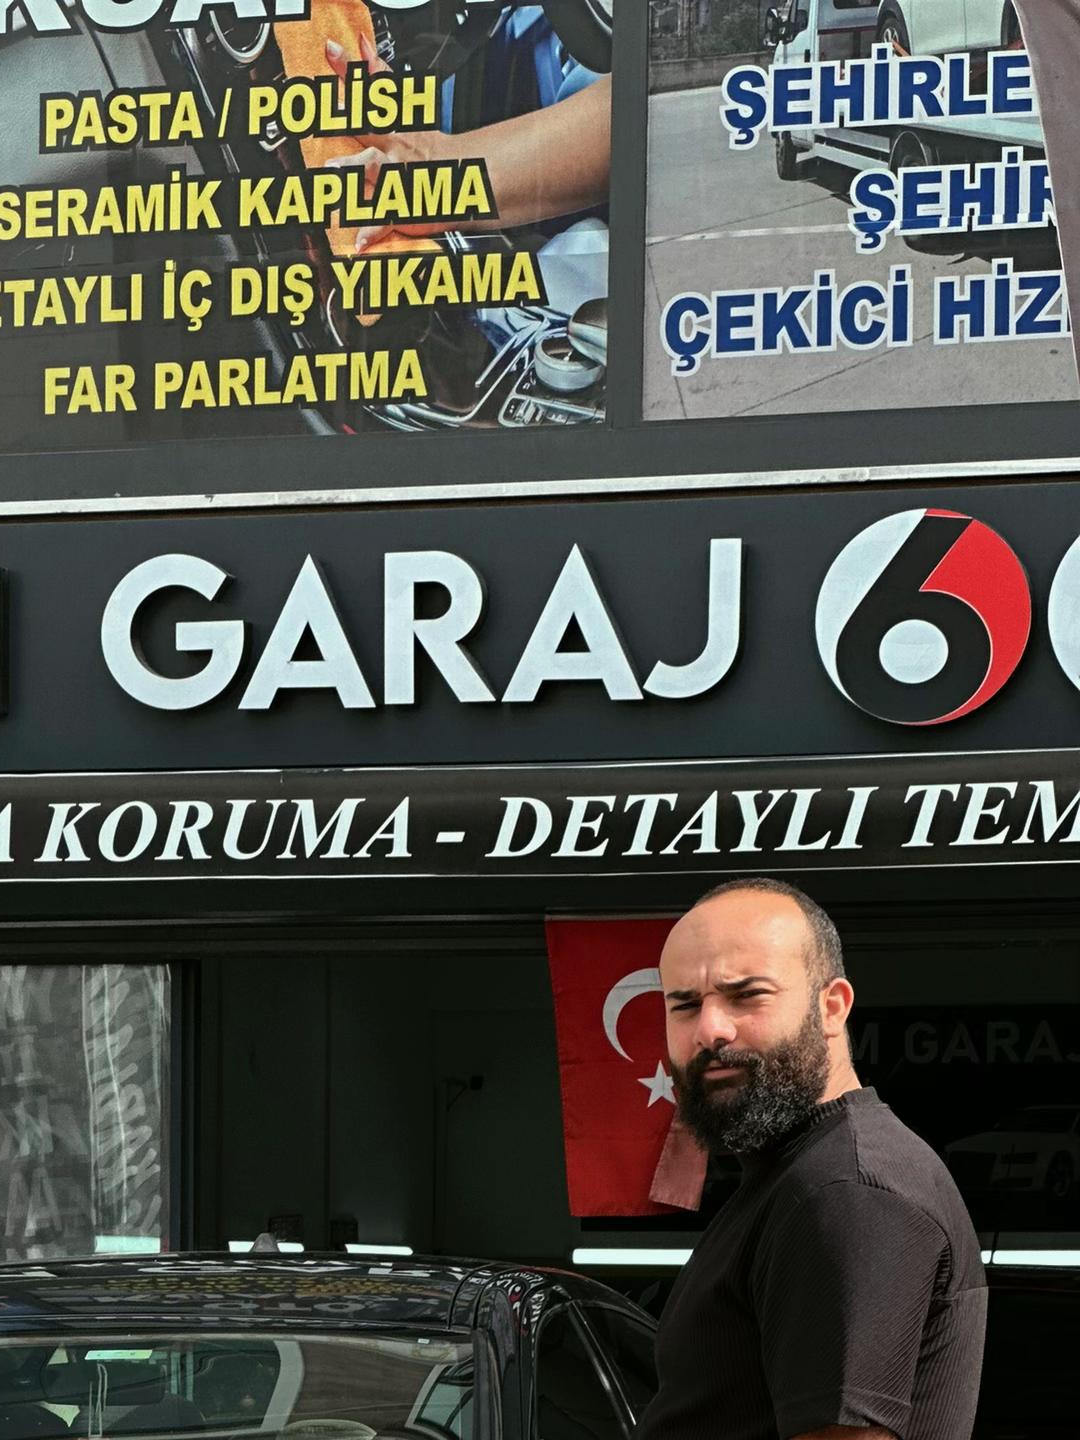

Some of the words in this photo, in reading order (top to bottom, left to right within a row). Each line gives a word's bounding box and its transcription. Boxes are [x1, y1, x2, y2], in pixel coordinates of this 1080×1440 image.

[45, 91, 204, 147] PASTA
[248, 68, 437, 135] POLİSH
[722, 43, 1035, 149] ŞEHİRLE
[238, 165, 491, 227] KAPLAMA
[162, 260, 213, 331] İÇ
[231, 263, 315, 325] DIŞ
[330, 252, 541, 310] YIKAMA
[661, 264, 913, 376] ÇEKİCİ
[934, 258, 1071, 344] HİZ
[44, 364, 137, 415] FAR
[154, 350, 428, 410] PARLATMA
[101, 538, 744, 711] GARAJ
[33, 796, 413, 863] KORUMA
[484, 786, 879, 858] DETAYLI
[904, 1021, 1080, 1064] GARA
